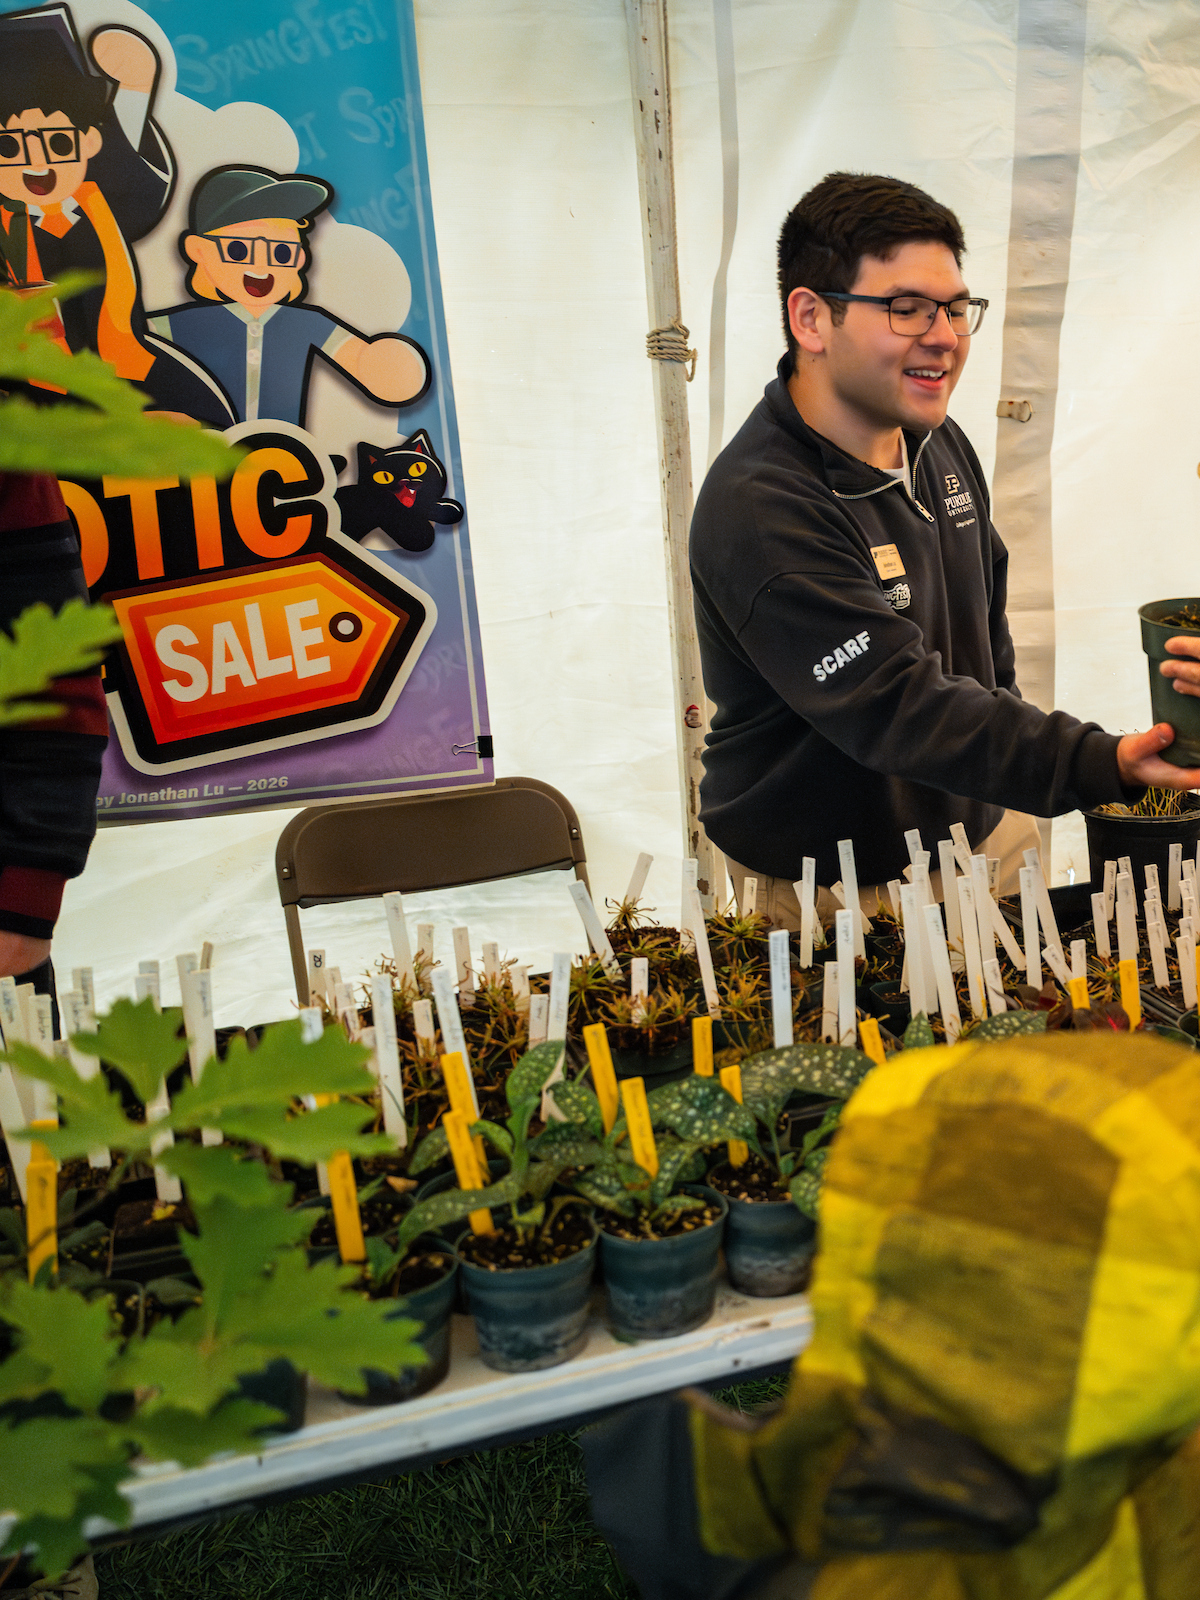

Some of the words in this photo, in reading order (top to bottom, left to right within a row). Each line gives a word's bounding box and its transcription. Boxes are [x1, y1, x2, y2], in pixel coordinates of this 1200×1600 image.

[944, 492, 973, 510] PURDUE
[155, 598, 331, 703] SALE
[812, 630, 871, 682] SCARF
[119, 787, 198, 804] Jonathan
[203, 784, 224, 797] Lu
[246, 775, 289, 792] 2026
